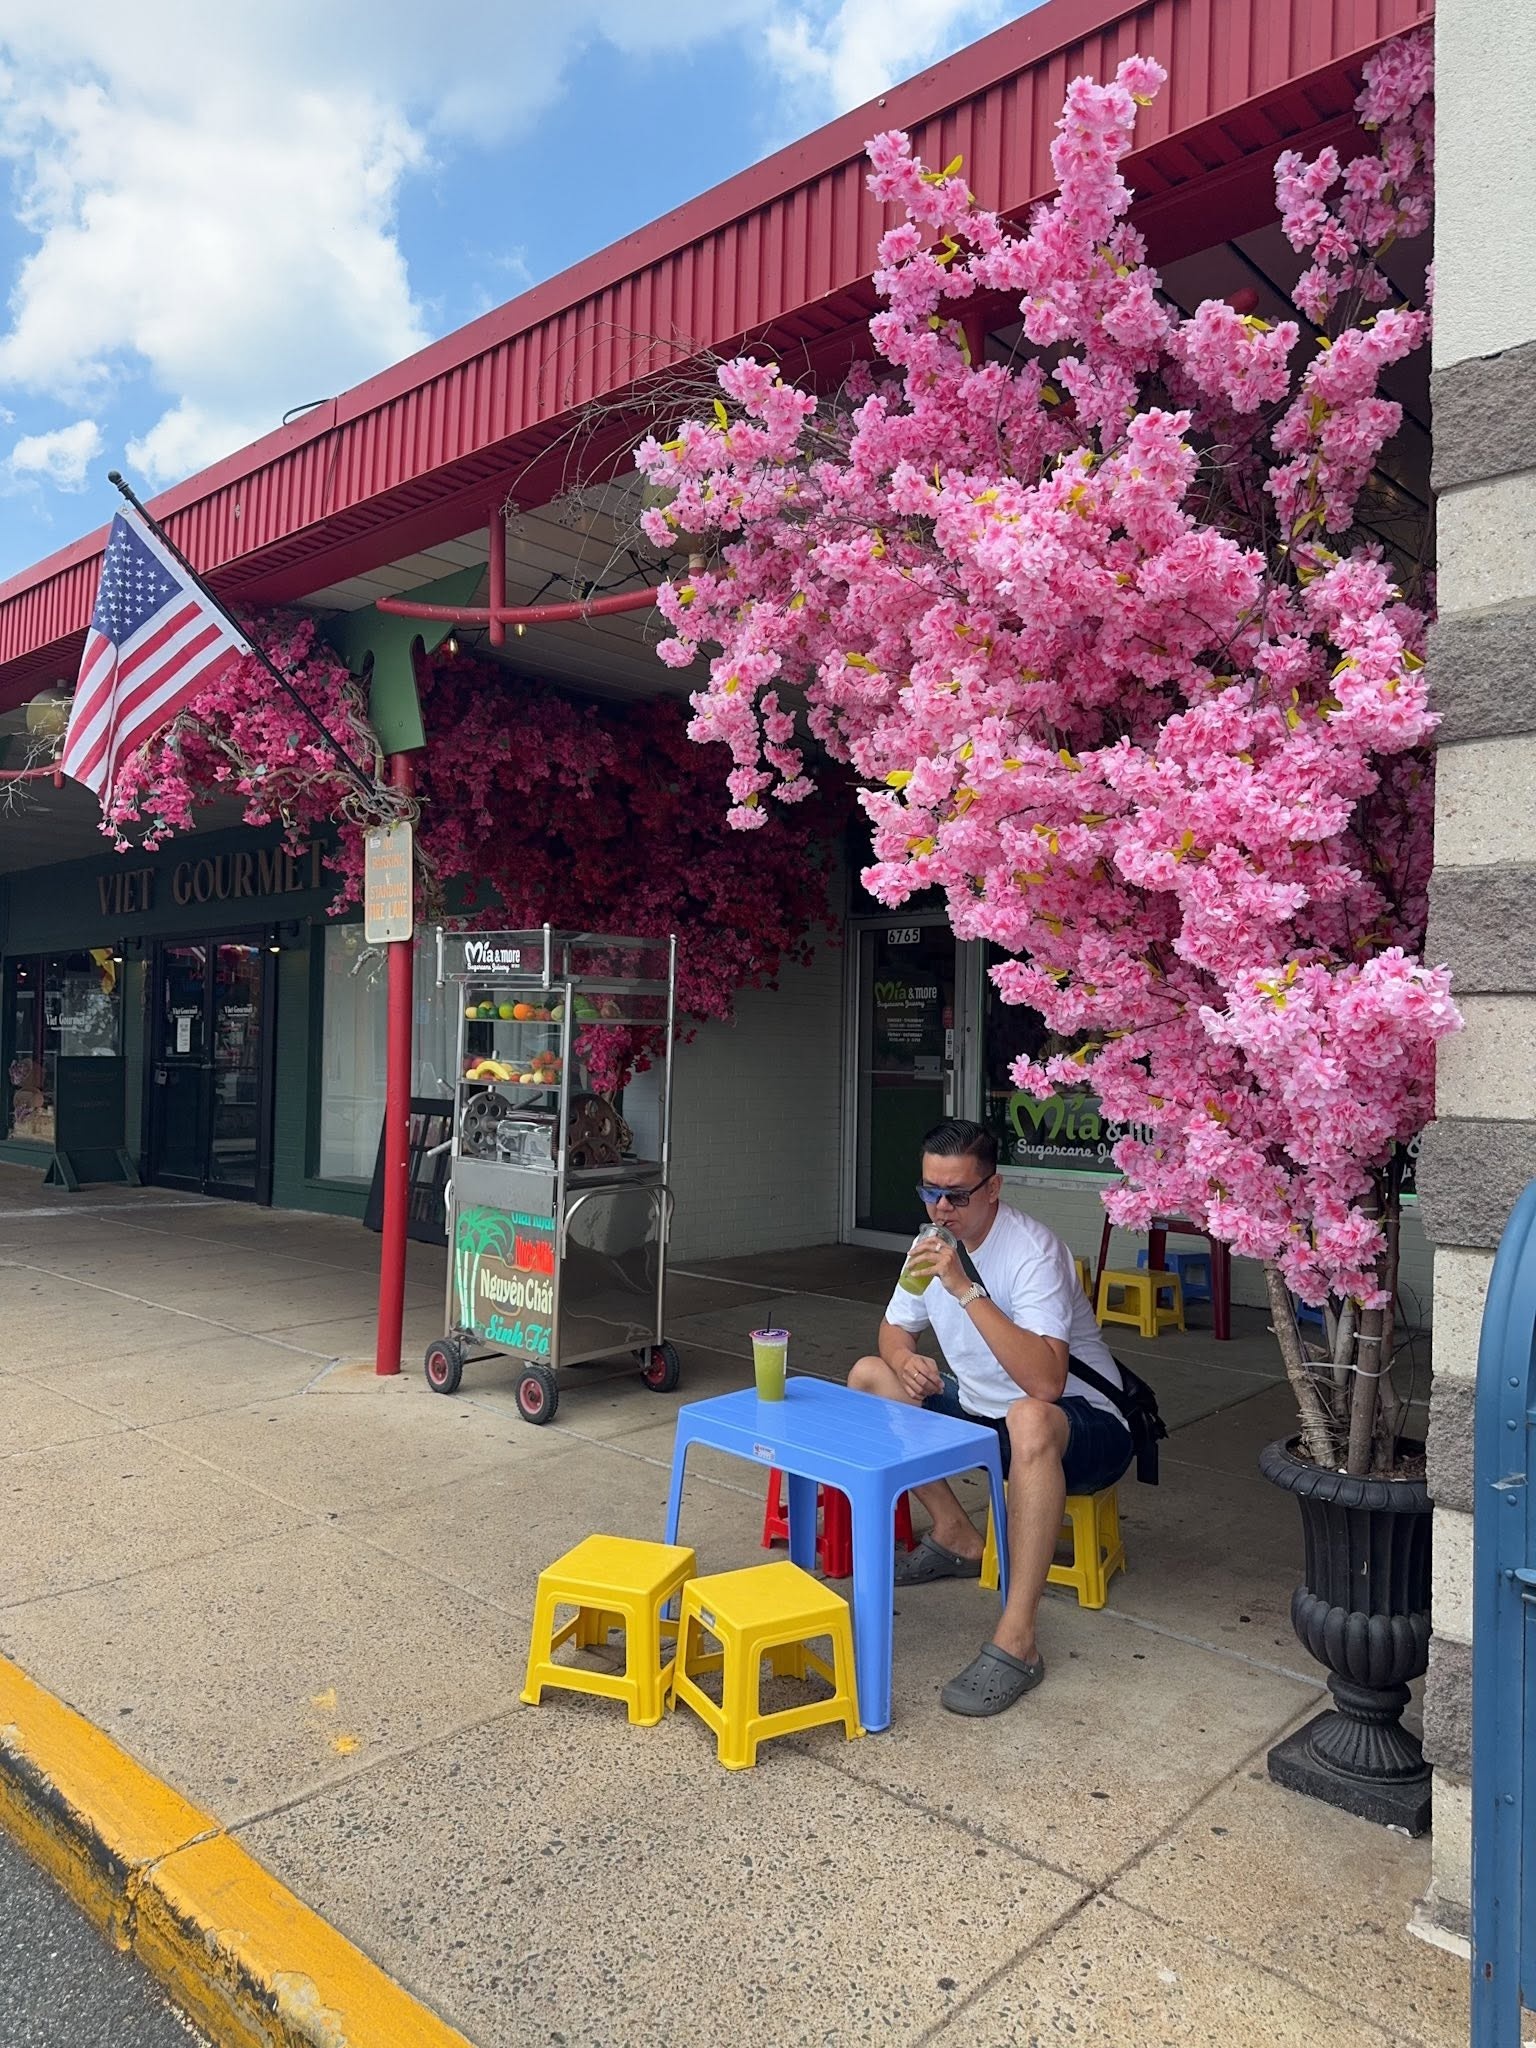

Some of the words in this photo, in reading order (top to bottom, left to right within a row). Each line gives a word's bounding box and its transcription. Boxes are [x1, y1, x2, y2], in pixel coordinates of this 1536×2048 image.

[97, 868, 154, 915] VIET
[172, 839, 328, 905] GOURMET
[370, 882, 407, 900] STANDING
[388, 900, 408, 919] LANE
[888, 929, 919, 943] 6765
[494, 949, 500, 963] &
[500, 949, 521, 963] more
[908, 988, 915, 999] &
[915, 986, 938, 999] more
[1106, 1120, 1122, 1141] &
[1017, 1138, 1094, 1160] Sugarcane
[480, 1268, 524, 1308] Nguyên
[525, 1279, 554, 1315] Chất
[485, 1314, 524, 1349] Sinh
